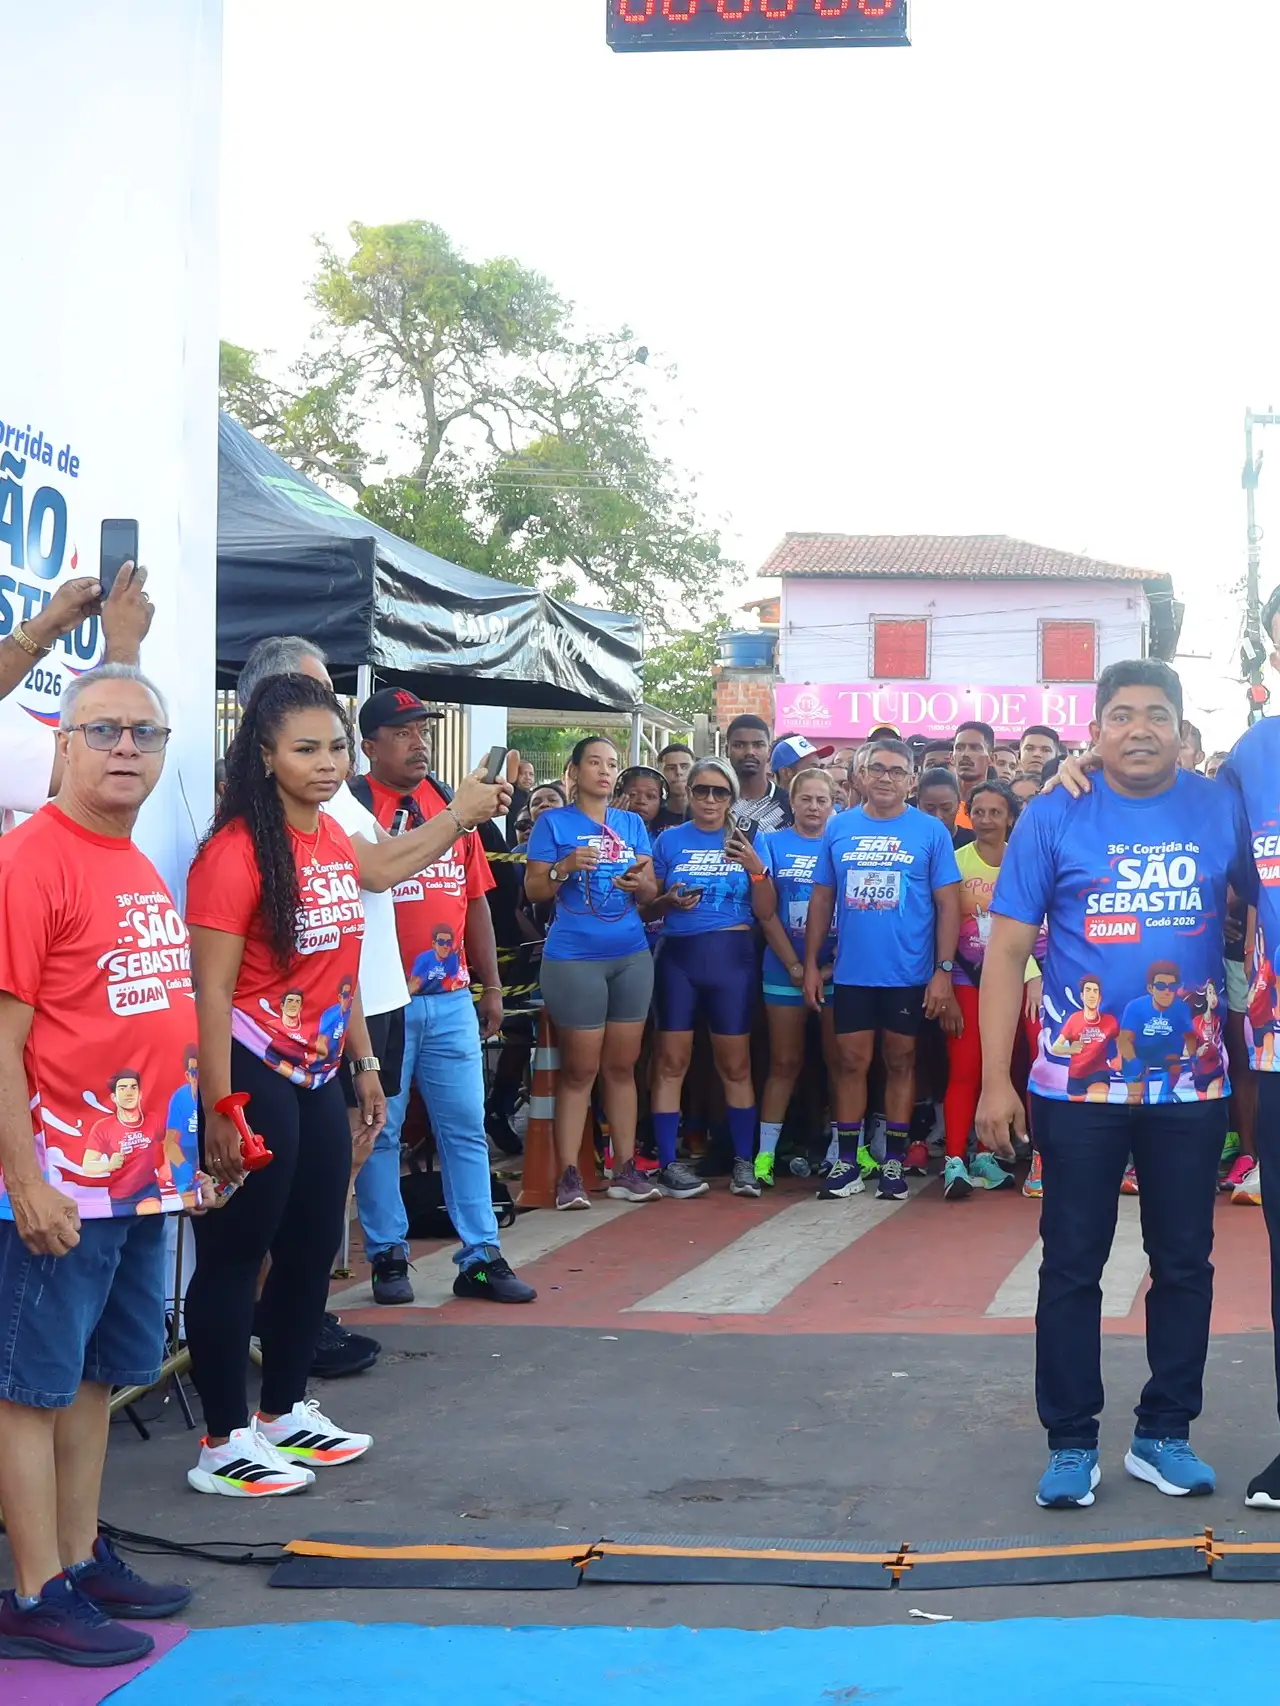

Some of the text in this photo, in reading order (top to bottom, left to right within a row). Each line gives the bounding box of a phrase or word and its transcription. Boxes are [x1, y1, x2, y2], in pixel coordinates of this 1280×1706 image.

[0, 421, 80, 478] orrida de
[0, 450, 67, 580] ÃO
[25, 668, 61, 697] 2026
[838, 691, 1098, 728] TUDO DE BL
[841, 850, 915, 865] SEBASTIÃO
[1132, 841, 1183, 855] Corrida
[1185, 842, 1200, 853] de
[313, 871, 359, 905] SÃO
[1116, 853, 1197, 890] SÃO
[853, 886, 895, 899] 14356
[133, 903, 186, 949] SÃO
[1145, 916, 1196, 927] Codó 2026
